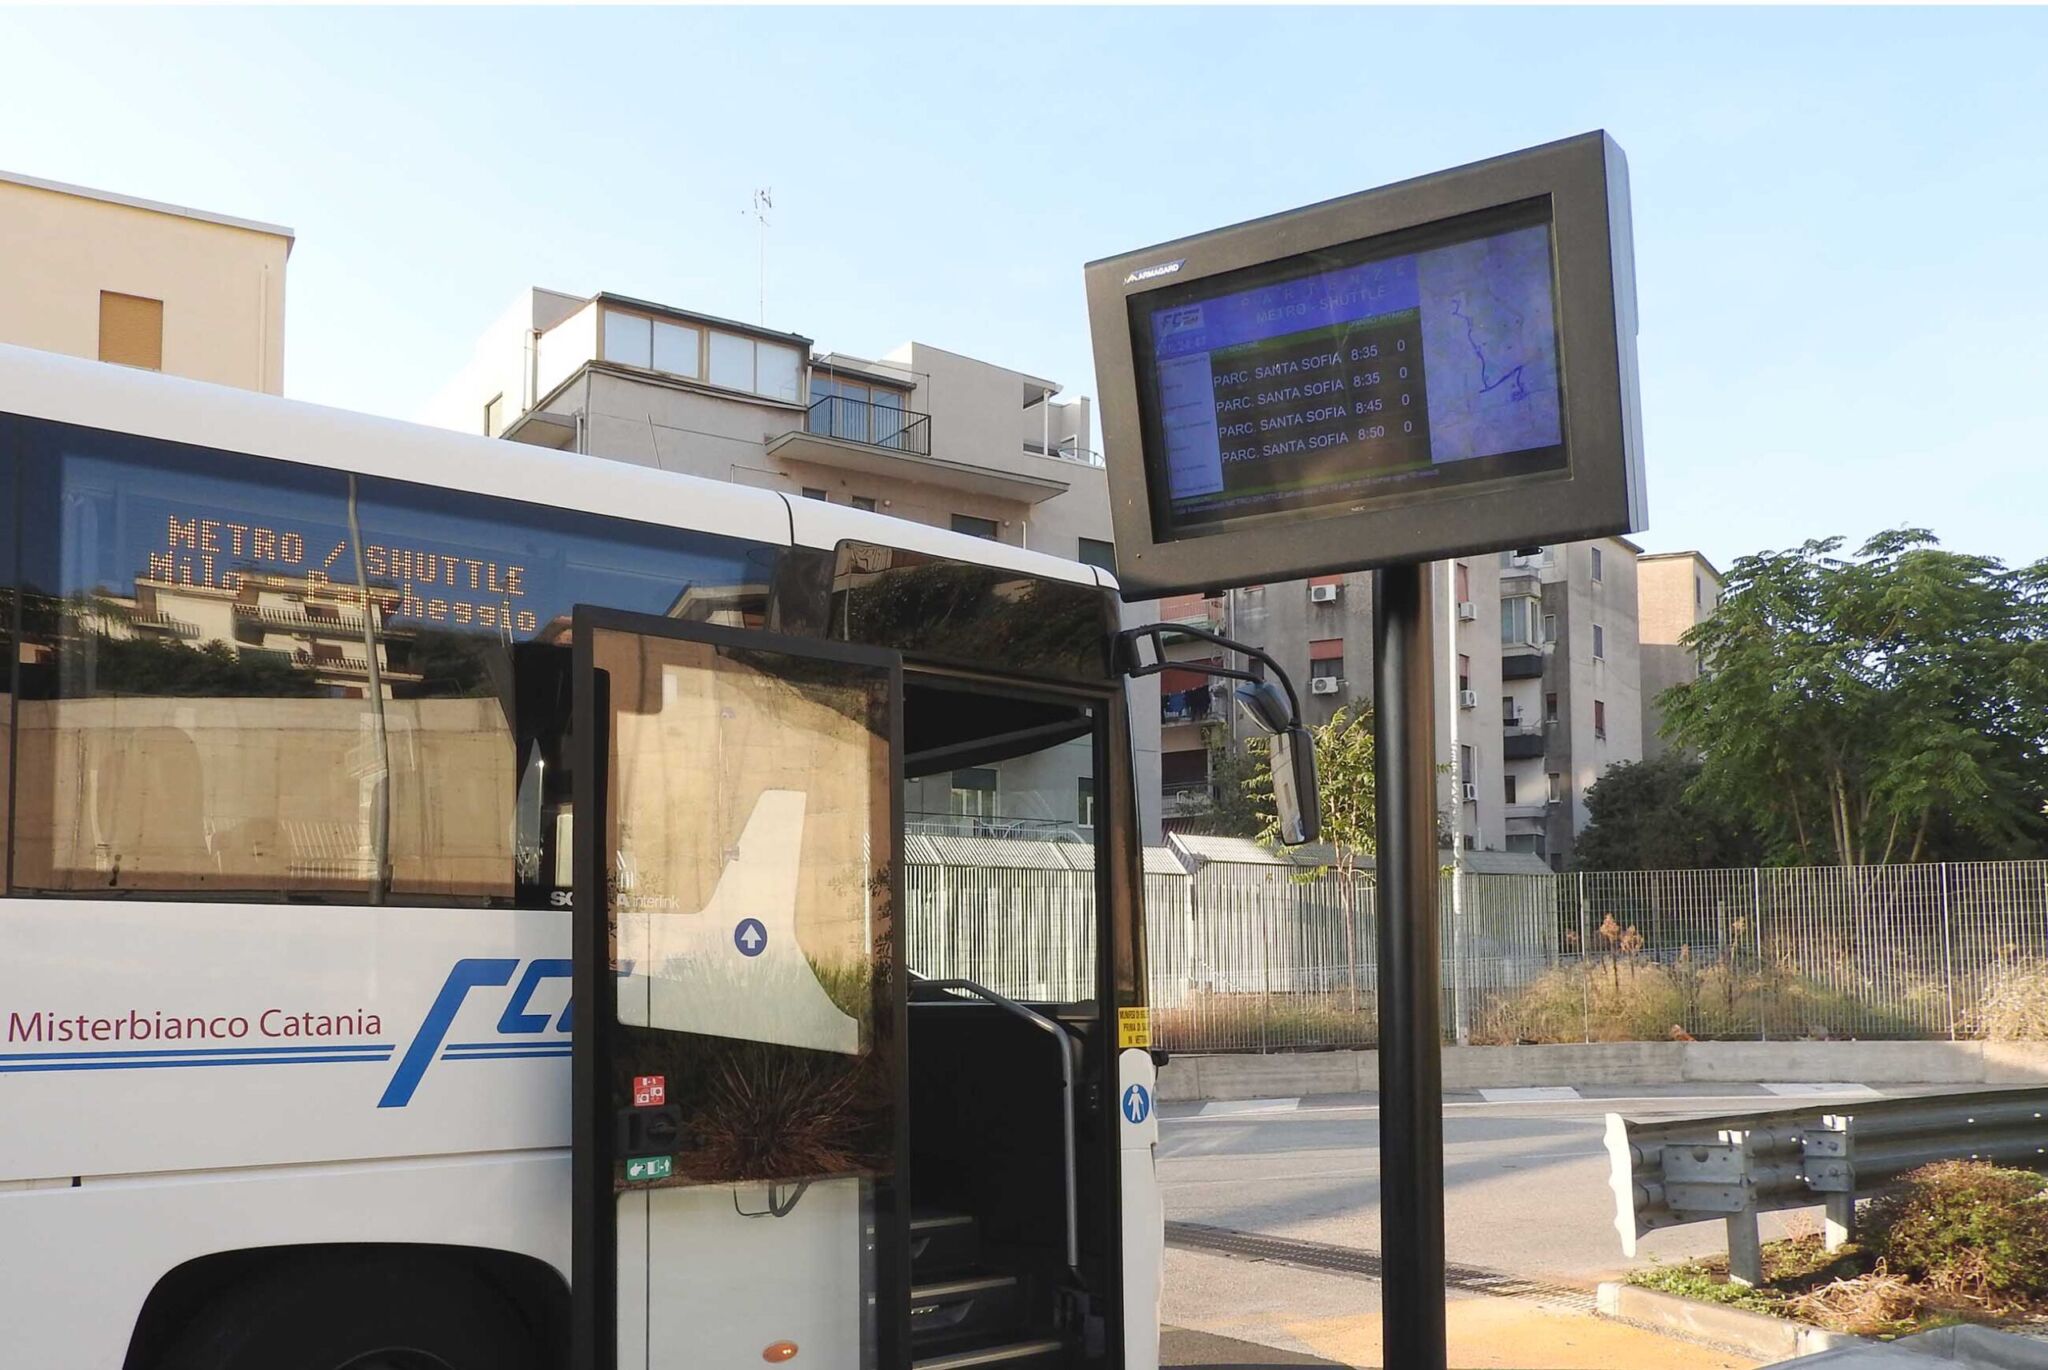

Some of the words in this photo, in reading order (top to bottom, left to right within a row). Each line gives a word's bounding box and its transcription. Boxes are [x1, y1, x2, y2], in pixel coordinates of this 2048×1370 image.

[1256, 302, 1307, 325] METRO
[1319, 288, 1386, 311] SHUTTLE
[1255, 363, 1298, 379] SANTA
[1302, 352, 1342, 370] SOFIA
[1351, 344, 1378, 360] 8:35
[1397, 339, 1406, 351] 0
[1216, 396, 1254, 413] PARC.
[1257, 388, 1300, 405] SANTA
[1304, 379, 1344, 397] SOFIA
[1353, 371, 1380, 388] 8:35
[1400, 366, 1408, 379] 0
[1218, 422, 1257, 438] PARC.
[1260, 415, 1303, 431] SANTA
[1306, 405, 1346, 423] SOFIA
[1356, 398, 1383, 414] 8:45
[1401, 394, 1410, 406] 0
[1221, 447, 1259, 464] PARC.
[1262, 440, 1306, 457] SANTA
[1308, 431, 1349, 449] SOFIA
[1358, 425, 1385, 441] 8:50
[1404, 420, 1412, 433] 0
[168, 513, 303, 564] METRO
[324, 540, 347, 568] /
[365, 544, 525, 597] SHUTTLE
[149, 550, 244, 595] Milo
[306, 568, 537, 633] Parcheggio
[8, 1009, 249, 1042] Misterbianco
[259, 1008, 382, 1038] Catania
